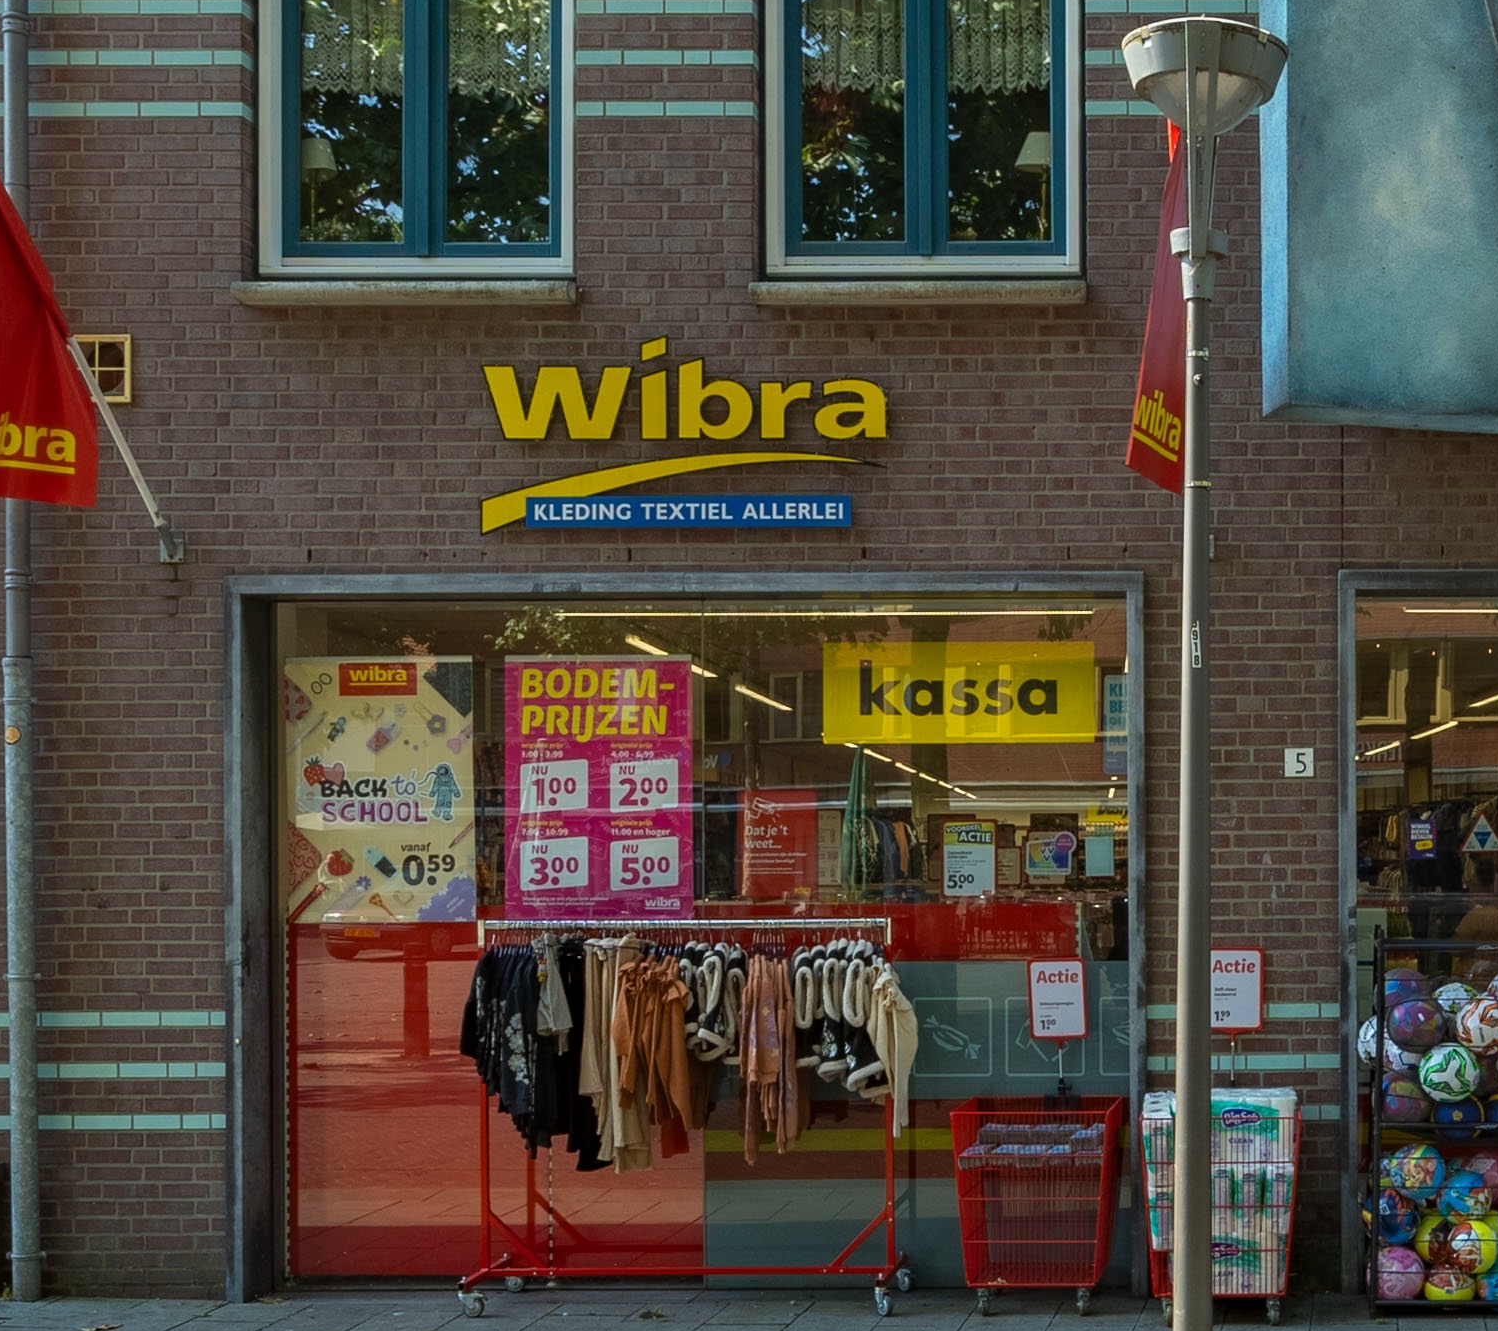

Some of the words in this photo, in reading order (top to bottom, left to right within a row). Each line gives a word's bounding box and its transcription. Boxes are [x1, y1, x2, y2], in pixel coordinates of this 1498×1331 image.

[534, 503, 632, 520] KLEDING
[641, 502, 733, 520] TEXTIEL
[742, 502, 844, 520] ALLERLEI
[349, 666, 408, 682] wibra
[521, 667, 675, 699] BODEM-
[859, 660, 1059, 716] kassa
[521, 704, 668, 743] PRIJZEN
[531, 765, 548, 775] NU
[618, 765, 636, 775] NU
[1295, 752, 1307, 774] 5
[320, 778, 387, 798] BACK
[391, 775, 416, 796] to
[531, 777, 577, 807] 1.00
[618, 777, 669, 807] 2.00
[321, 799, 428, 823] SCHOOL
[645, 828, 670, 838] hoger
[745, 825, 765, 836] Dat
[766, 825, 778, 837] je
[958, 831, 992, 843] ACTIE
[400, 842, 432, 852] vanaf
[531, 844, 549, 854] NU
[621, 843, 639, 854] NU
[401, 854, 456, 886] 0.59
[528, 856, 579, 886] 3.00
[621, 856, 670, 886] 5.00
[946, 873, 975, 889] 5.00
[644, 897, 681, 908] wibra
[1212, 957, 1256, 974] Actie
[1035, 968, 1079, 984] Actie
[1040, 1018, 1057, 1030] 1.00
